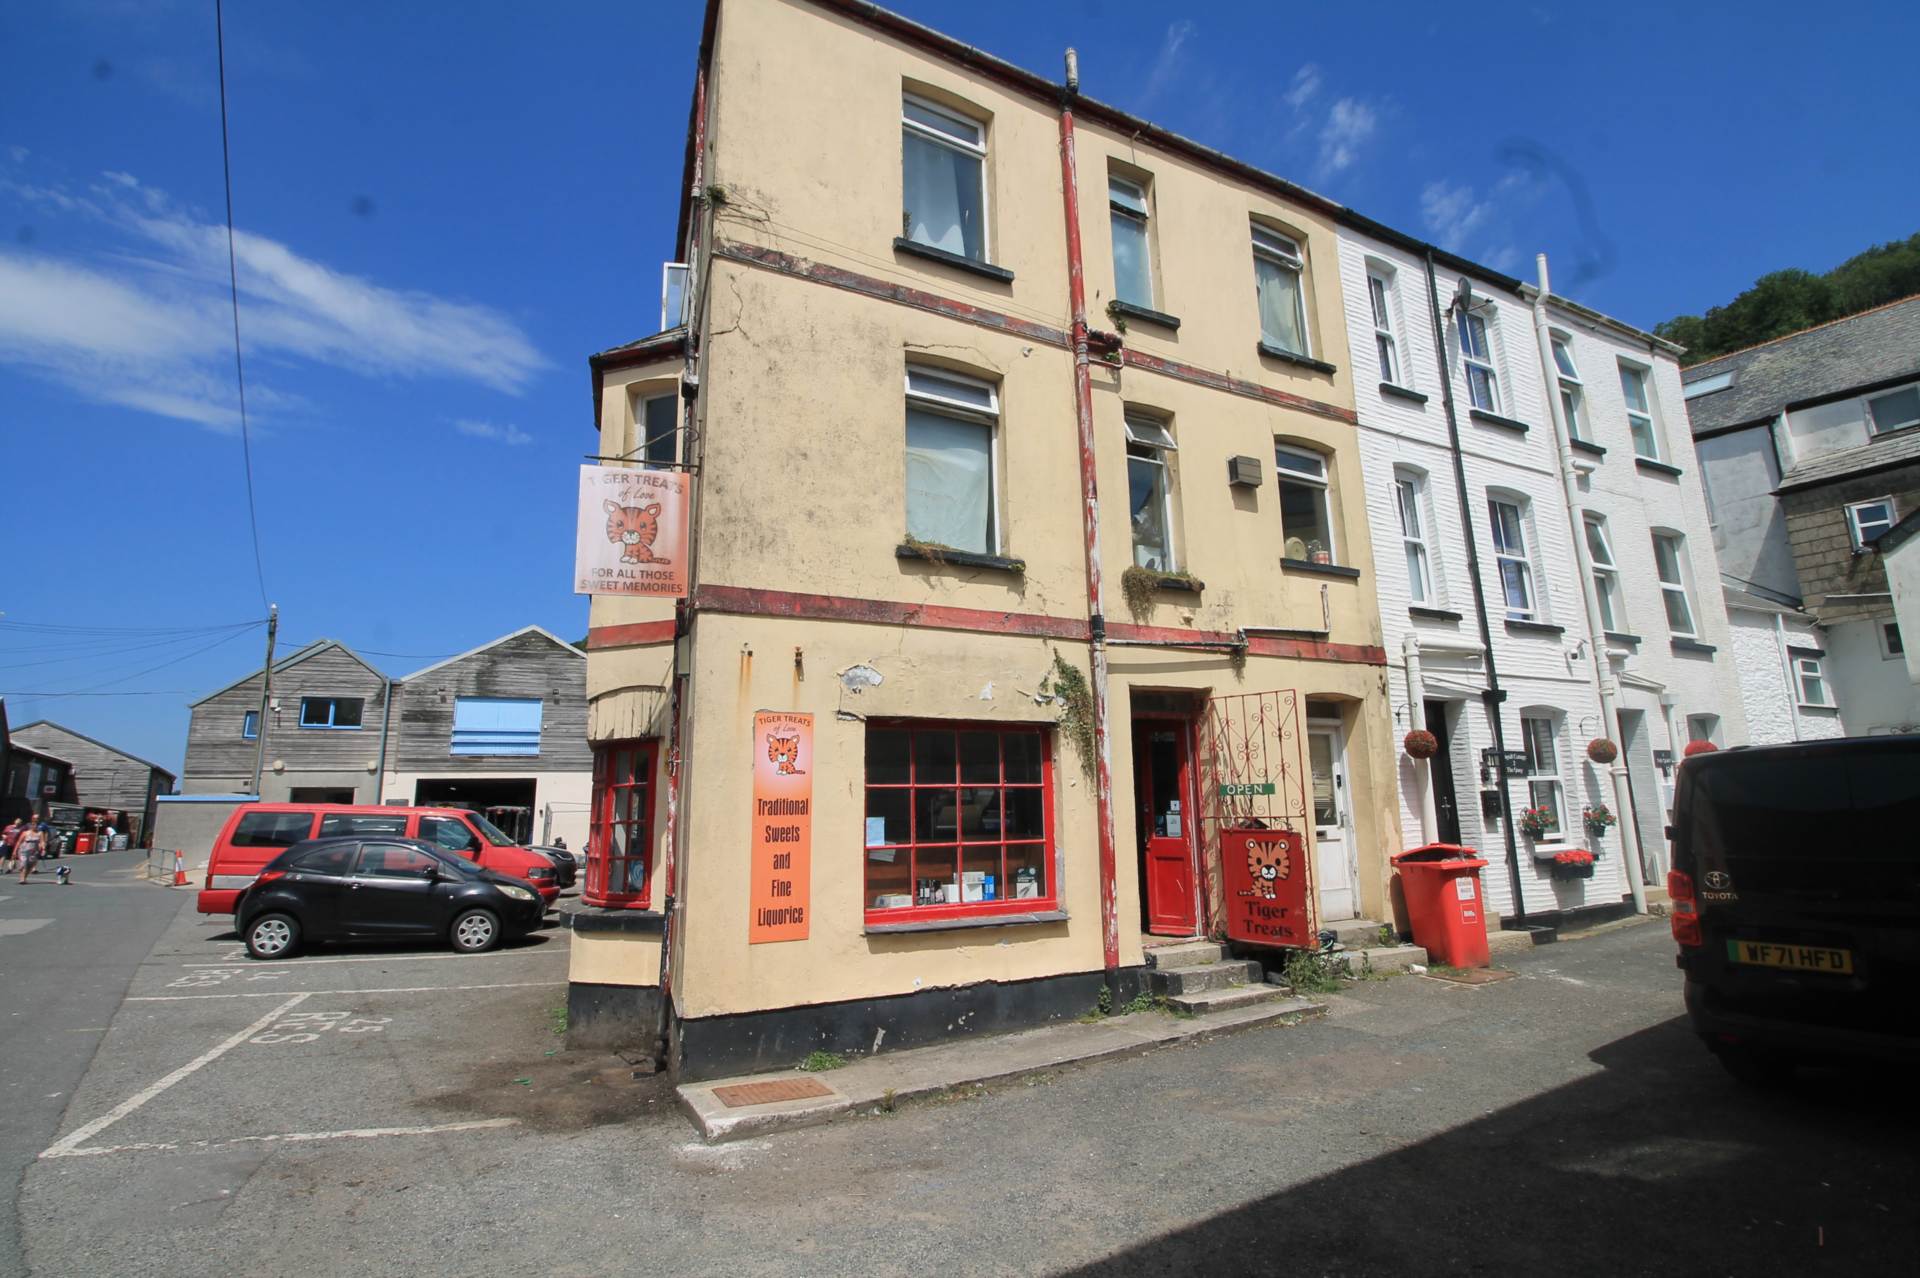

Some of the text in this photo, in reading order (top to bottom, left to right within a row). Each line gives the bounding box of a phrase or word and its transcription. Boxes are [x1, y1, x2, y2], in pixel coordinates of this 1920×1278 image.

[618, 486, 656, 502] of Love
[592, 567, 676, 581] FOR ALL THOSE
[580, 579, 684, 594] SWEET MEMORIES
[759, 715, 811, 727] TIGER TREATS
[1226, 784, 1264, 795] OPEN
[757, 798, 809, 816] Traditional
[765, 825, 800, 843] Sweets
[773, 852, 791, 870] and
[771, 879, 792, 897] Fine
[1702, 891, 1739, 900] TOYOTA
[757, 906, 804, 927] Liquorice
[1244, 900, 1289, 920] Tiger
[1243, 919, 1295, 938] Treats
[1746, 944, 1844, 969] WF71 HFD
[250, 1011, 352, 1044] RES
[338, 1017, 393, 1033] 25
